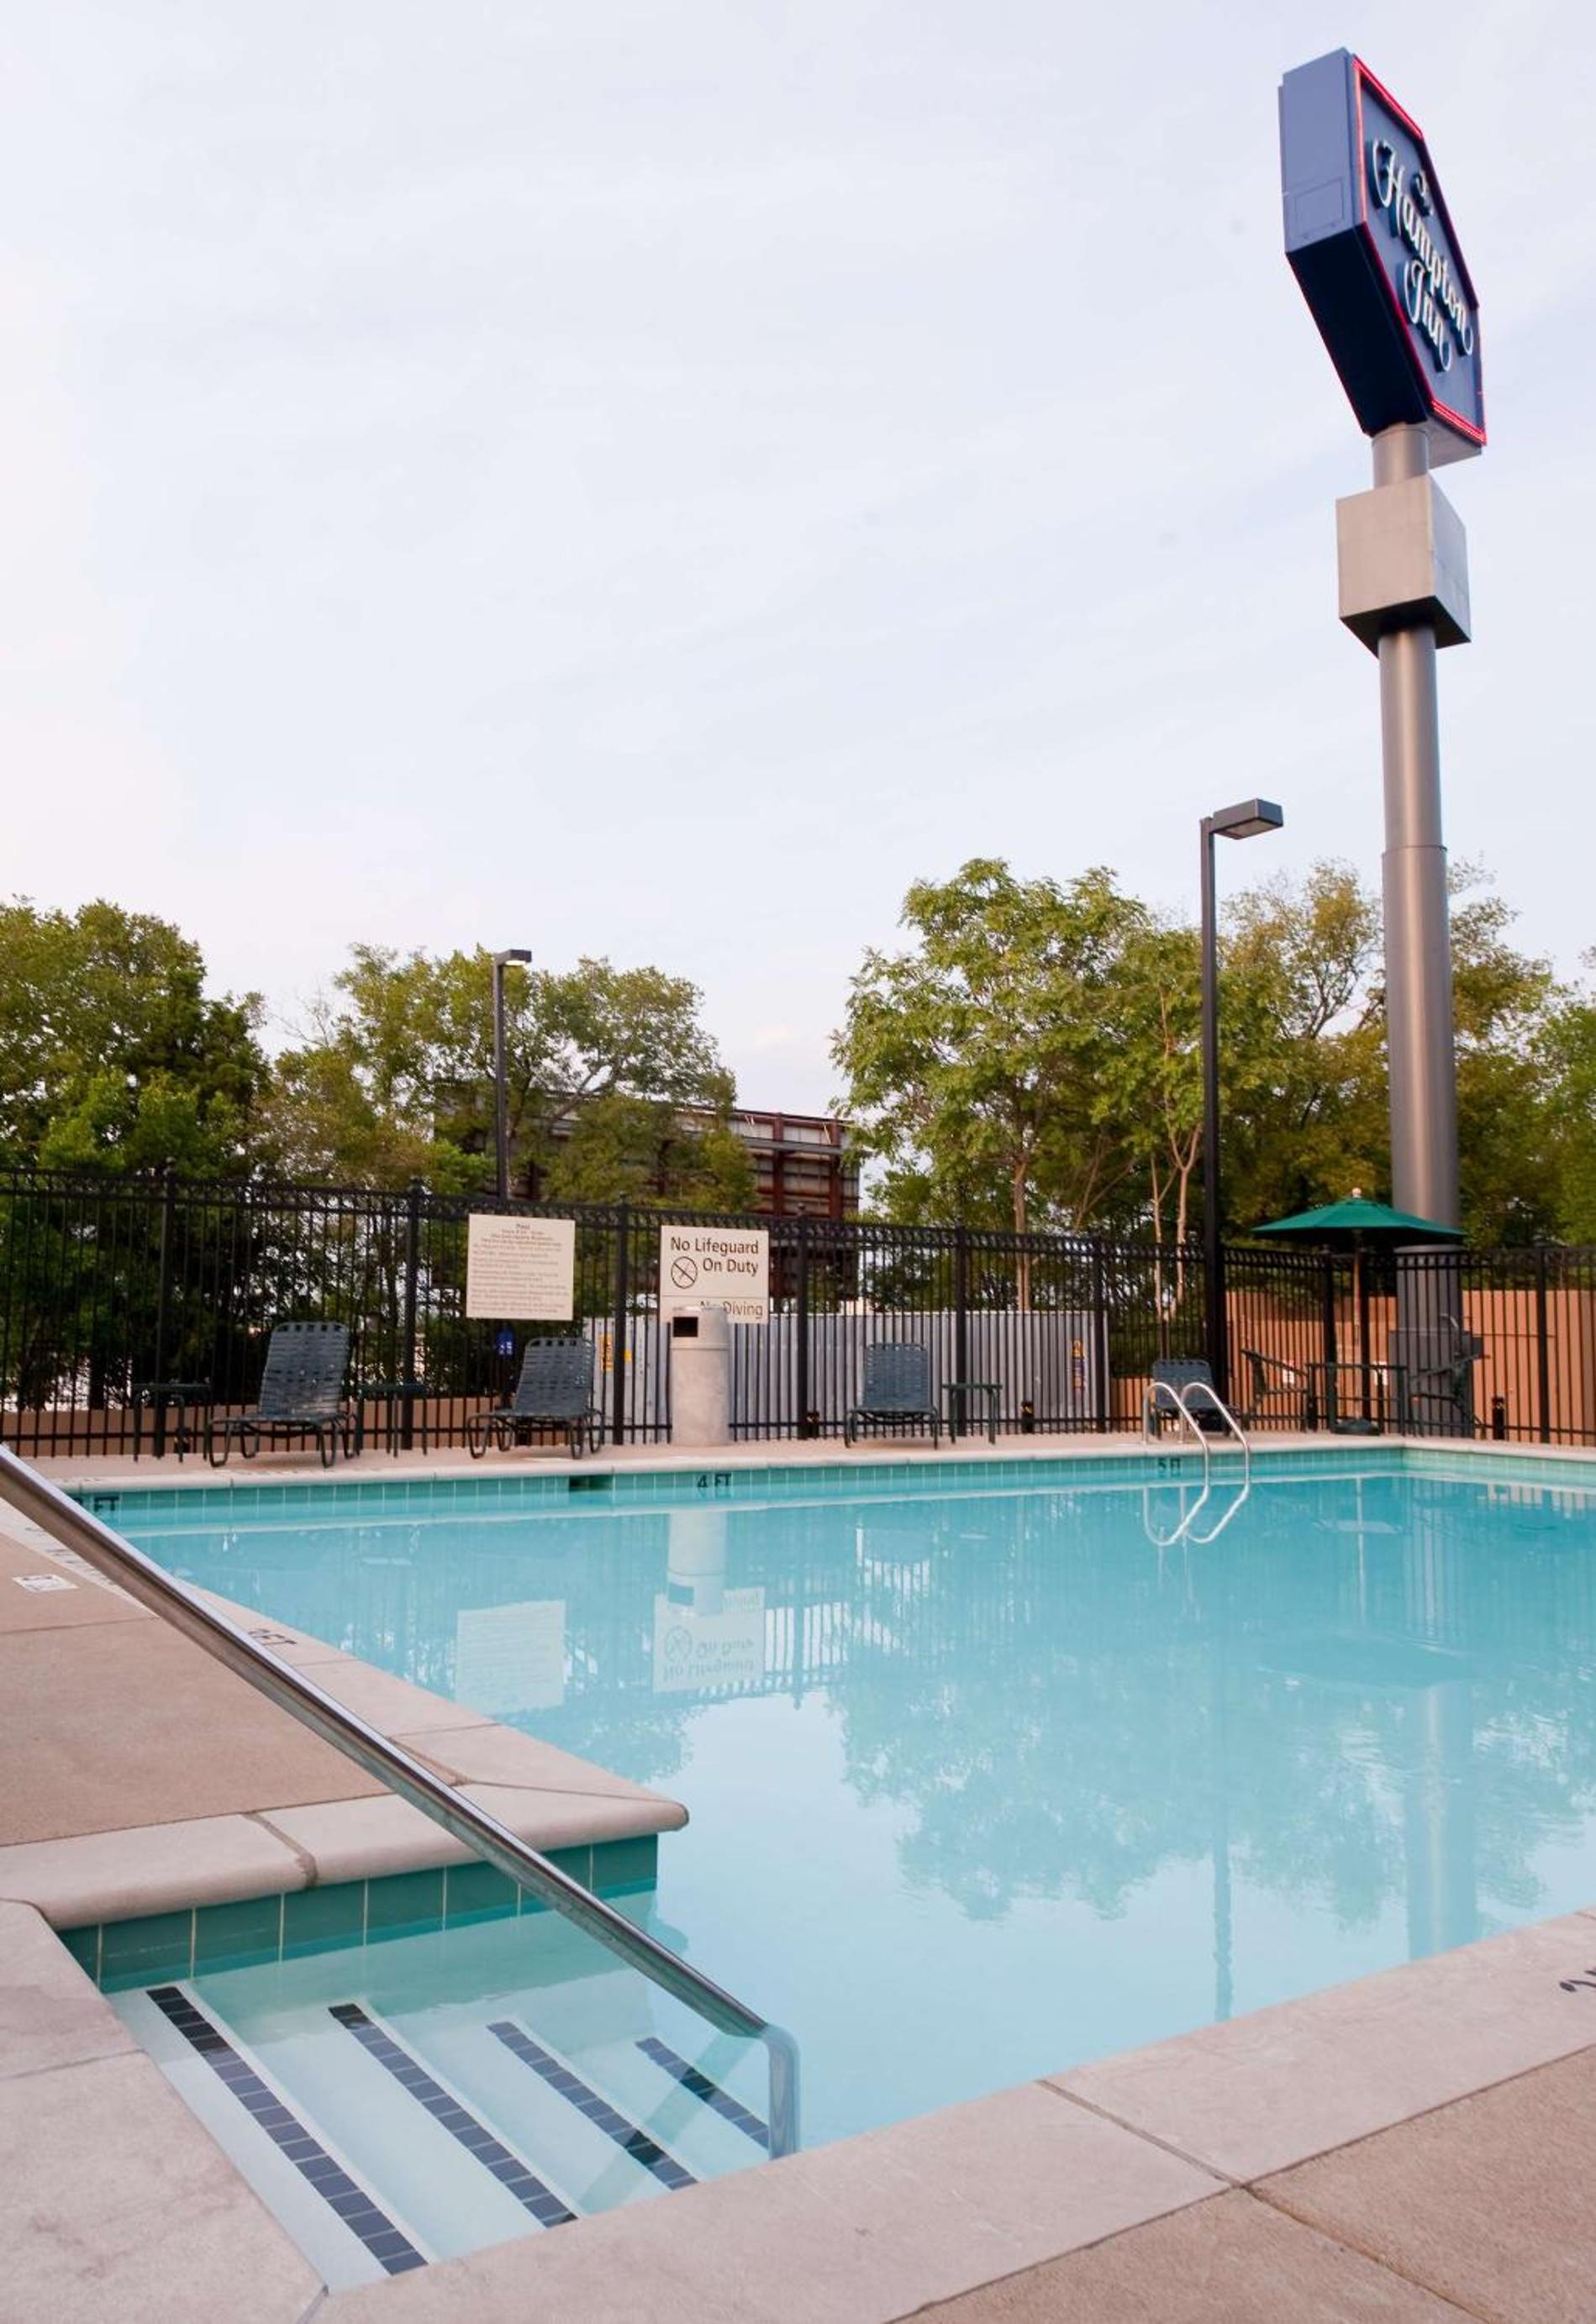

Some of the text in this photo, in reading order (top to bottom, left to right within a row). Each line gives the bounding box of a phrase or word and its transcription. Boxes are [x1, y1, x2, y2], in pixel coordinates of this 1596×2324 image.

[1372, 138, 1473, 356] Hampton
[1404, 259, 1451, 372] Inn
[671, 1237, 759, 1256] No Lifeguard
[703, 1257, 758, 1276] On Duty
[723, 1301, 763, 1319] Diving
[698, 1473, 732, 1487] 4 FT
[93, 1496, 119, 1512] FT
